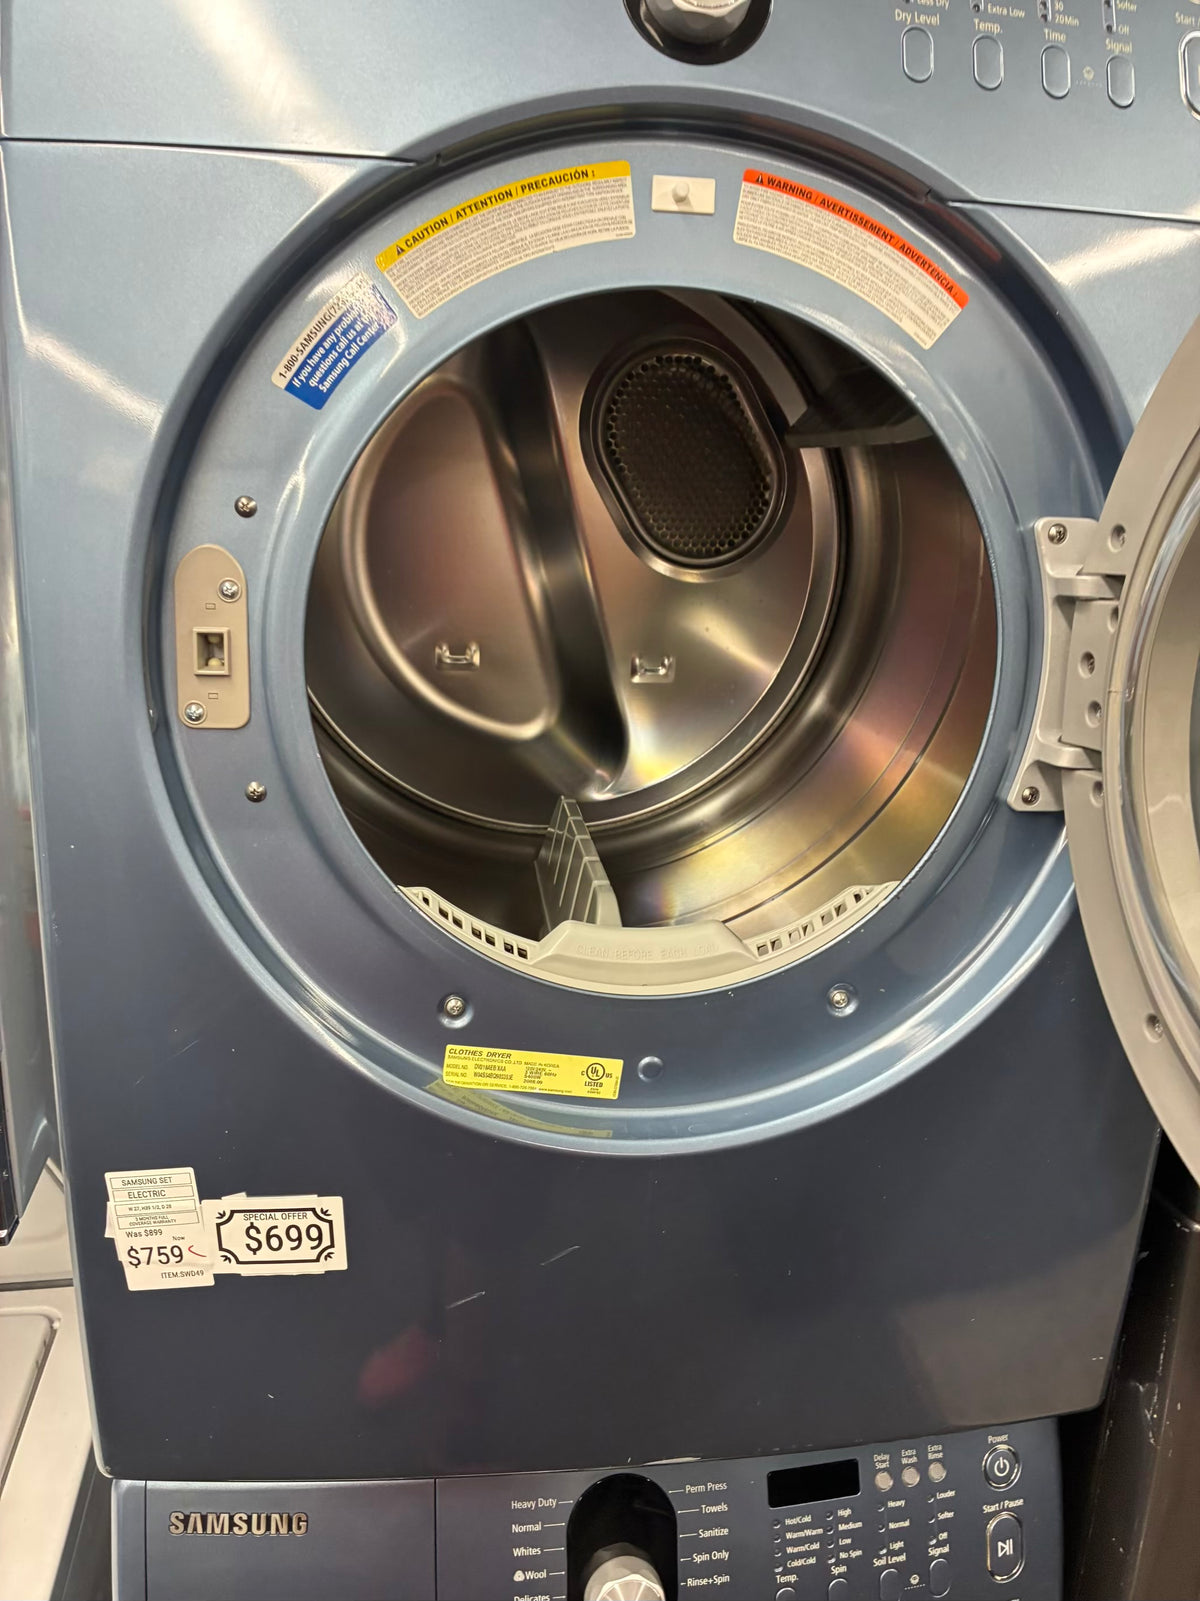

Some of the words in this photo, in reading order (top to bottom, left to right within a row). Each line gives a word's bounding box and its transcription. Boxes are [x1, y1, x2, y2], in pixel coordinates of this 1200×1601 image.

[987, 3, 1007, 16] Extra
[1009, 6, 1026, 18] Low
[895, 8, 911, 25] Dry
[914, 11, 940, 26] Level
[1175, 11, 1195, 26] Start
[974, 18, 1003, 36] Temp.
[1118, 24, 1130, 35] Off
[1044, 28, 1067, 43] Time
[1105, 37, 1132, 54] Signal
[404, 214, 449, 248] CAUTION
[455, 189, 514, 220] ATTENTION
[520, 168, 590, 195] PRECAUCIÓN
[767, 176, 813, 200] WARNING
[819, 198, 895, 244] AVERTISSEMENT
[899, 243, 955, 294] ADVERTENCIA
[308, 350, 339, 388] questions
[335, 335, 350, 353] call
[349, 328, 358, 341] us
[355, 319, 365, 332] at
[318, 358, 350, 393] Samsung
[344, 341, 360, 360] Call
[356, 321, 380, 346] Center
[291, 376, 302, 388] If
[298, 365, 312, 383] you
[307, 345, 326, 367] have
[322, 332, 338, 351] any
[449, 1048, 483, 1057] CLOTHES
[486, 1051, 512, 1059] DRYER
[121, 1177, 158, 1187] SAMSUNG
[127, 1189, 166, 1199] ELECTRIC
[243, 1213, 279, 1221] SPECIAL
[281, 1212, 308, 1220] OFFER
[125, 1230, 142, 1238] Was
[144, 1228, 163, 1237] $899
[245, 1221, 323, 1255] $699
[127, 1245, 184, 1269] $759
[988, 1434, 1009, 1444] Power
[901, 1449, 916, 1457] Extra
[927, 1444, 942, 1452] Extra
[873, 1453, 890, 1462] Delay
[901, 1456, 918, 1465] Wash
[928, 1451, 944, 1460] Rinse
[875, 1461, 890, 1470] Start
[685, 1485, 705, 1494] Perm
[707, 1482, 727, 1491] Press
[936, 1489, 956, 1499] Louder
[511, 1500, 536, 1510] Heavy
[538, 1498, 557, 1508] Duty
[701, 1502, 728, 1514] Towels
[887, 1499, 906, 1508] Heavy
[982, 1503, 1000, 1514] Start
[1004, 1498, 1024, 1509] Pause
[837, 1507, 852, 1518] High
[937, 1511, 954, 1520] Softer
[168, 1510, 308, 1536] SAMSUNG
[785, 1514, 812, 1526] Hot/Cold
[838, 1521, 863, 1531] Medium
[888, 1519, 910, 1530] Normal
[511, 1521, 542, 1533] Normal
[698, 1526, 729, 1538] Sanitize
[785, 1527, 824, 1540] Warm/Warm
[938, 1531, 948, 1540] Off
[786, 1541, 820, 1554] Warm/Cold
[839, 1537, 852, 1546] Low
[889, 1540, 905, 1551] Light
[513, 1546, 541, 1557] Whites
[692, 1551, 710, 1564] Spin
[711, 1549, 730, 1561] Only
[839, 1551, 849, 1560] No
[849, 1549, 863, 1559] Spin
[928, 1544, 950, 1557] Signal
[786, 1556, 817, 1568] Cold/Cold
[873, 1555, 886, 1567] Soil
[887, 1552, 907, 1565] Level
[525, 1569, 547, 1580] Wool
[830, 1564, 848, 1576] Spin
[686, 1574, 730, 1587] Rinse+Spin
[776, 1573, 799, 1584] Temp.
